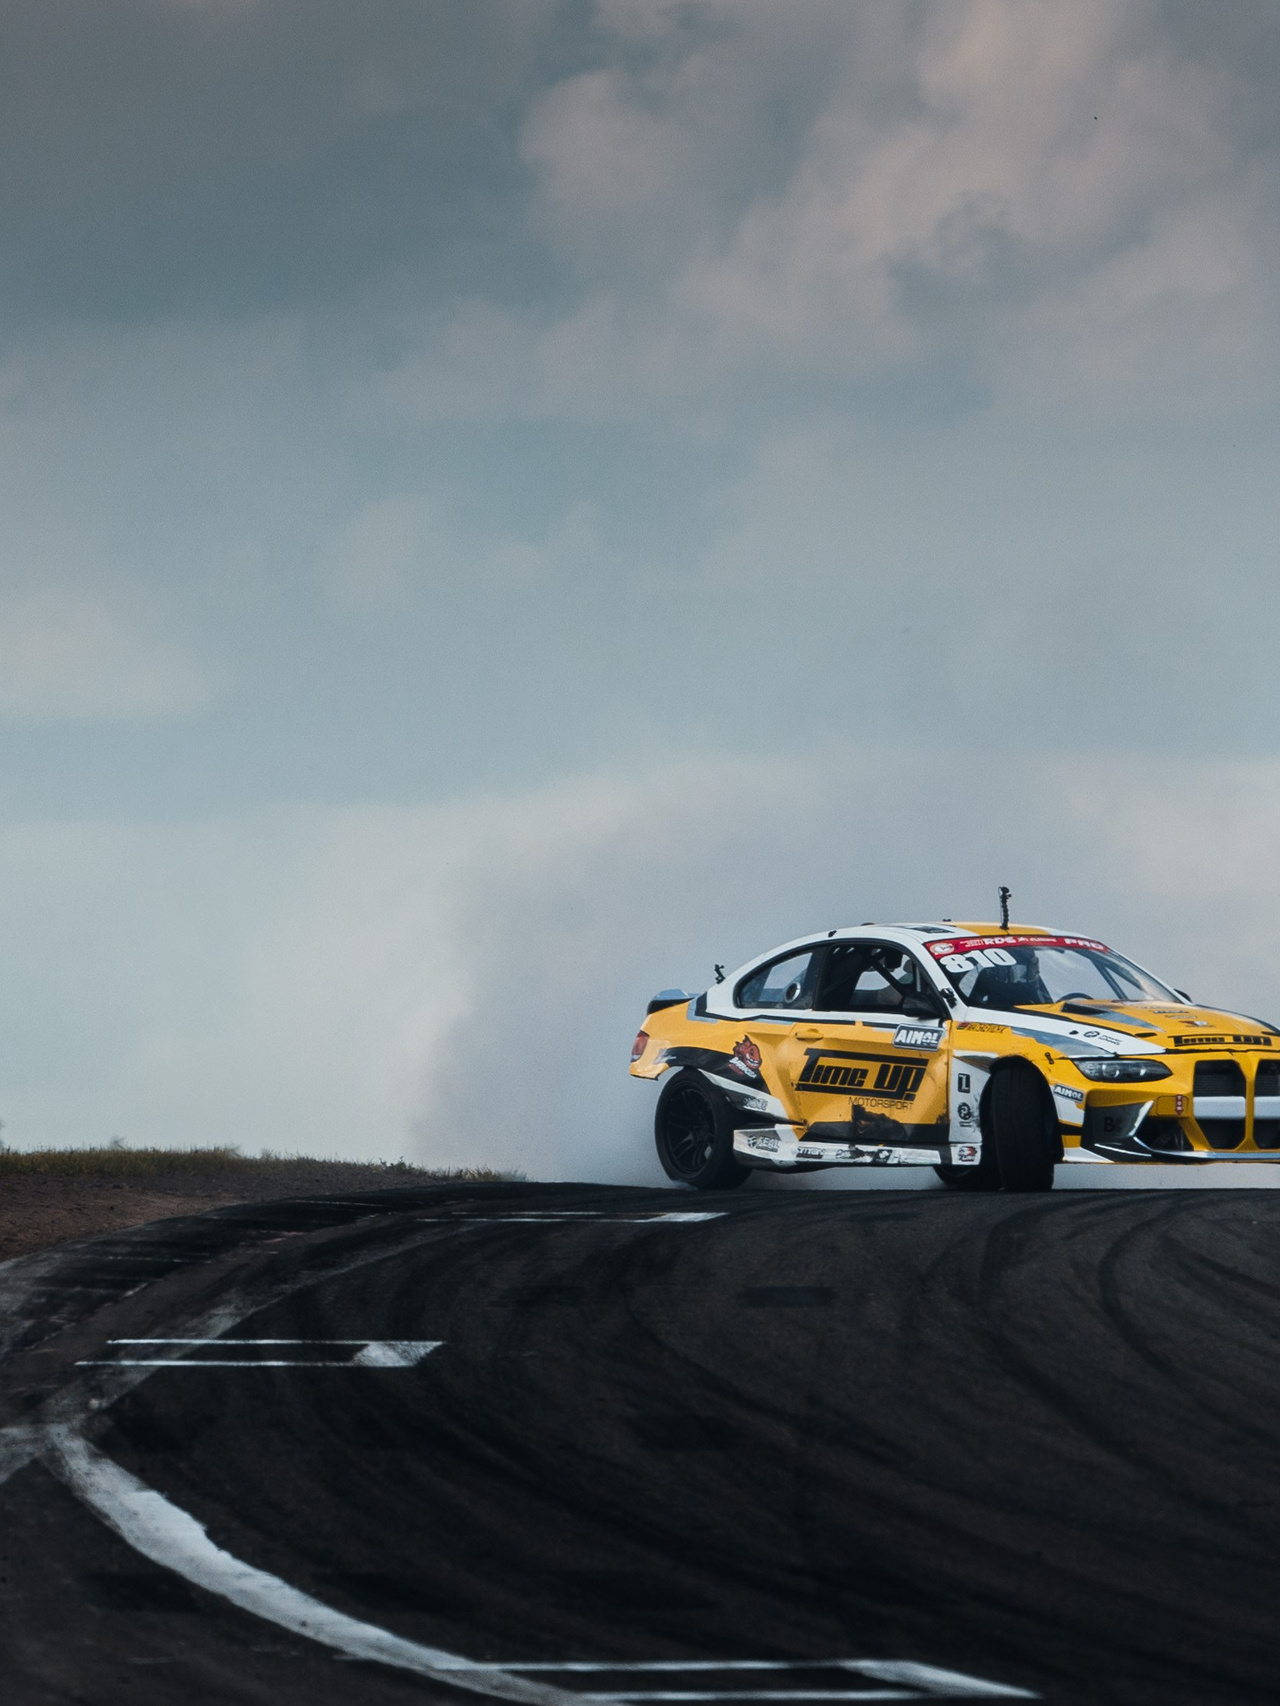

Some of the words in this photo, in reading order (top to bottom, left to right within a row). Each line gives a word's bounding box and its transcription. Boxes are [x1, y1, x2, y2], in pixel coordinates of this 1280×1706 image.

[939, 948, 1017, 973] 810
[894, 1030, 939, 1045] AIMOL
[1054, 1086, 1083, 1099] AIMOL
[848, 1097, 914, 1111] MOTORSPORT
